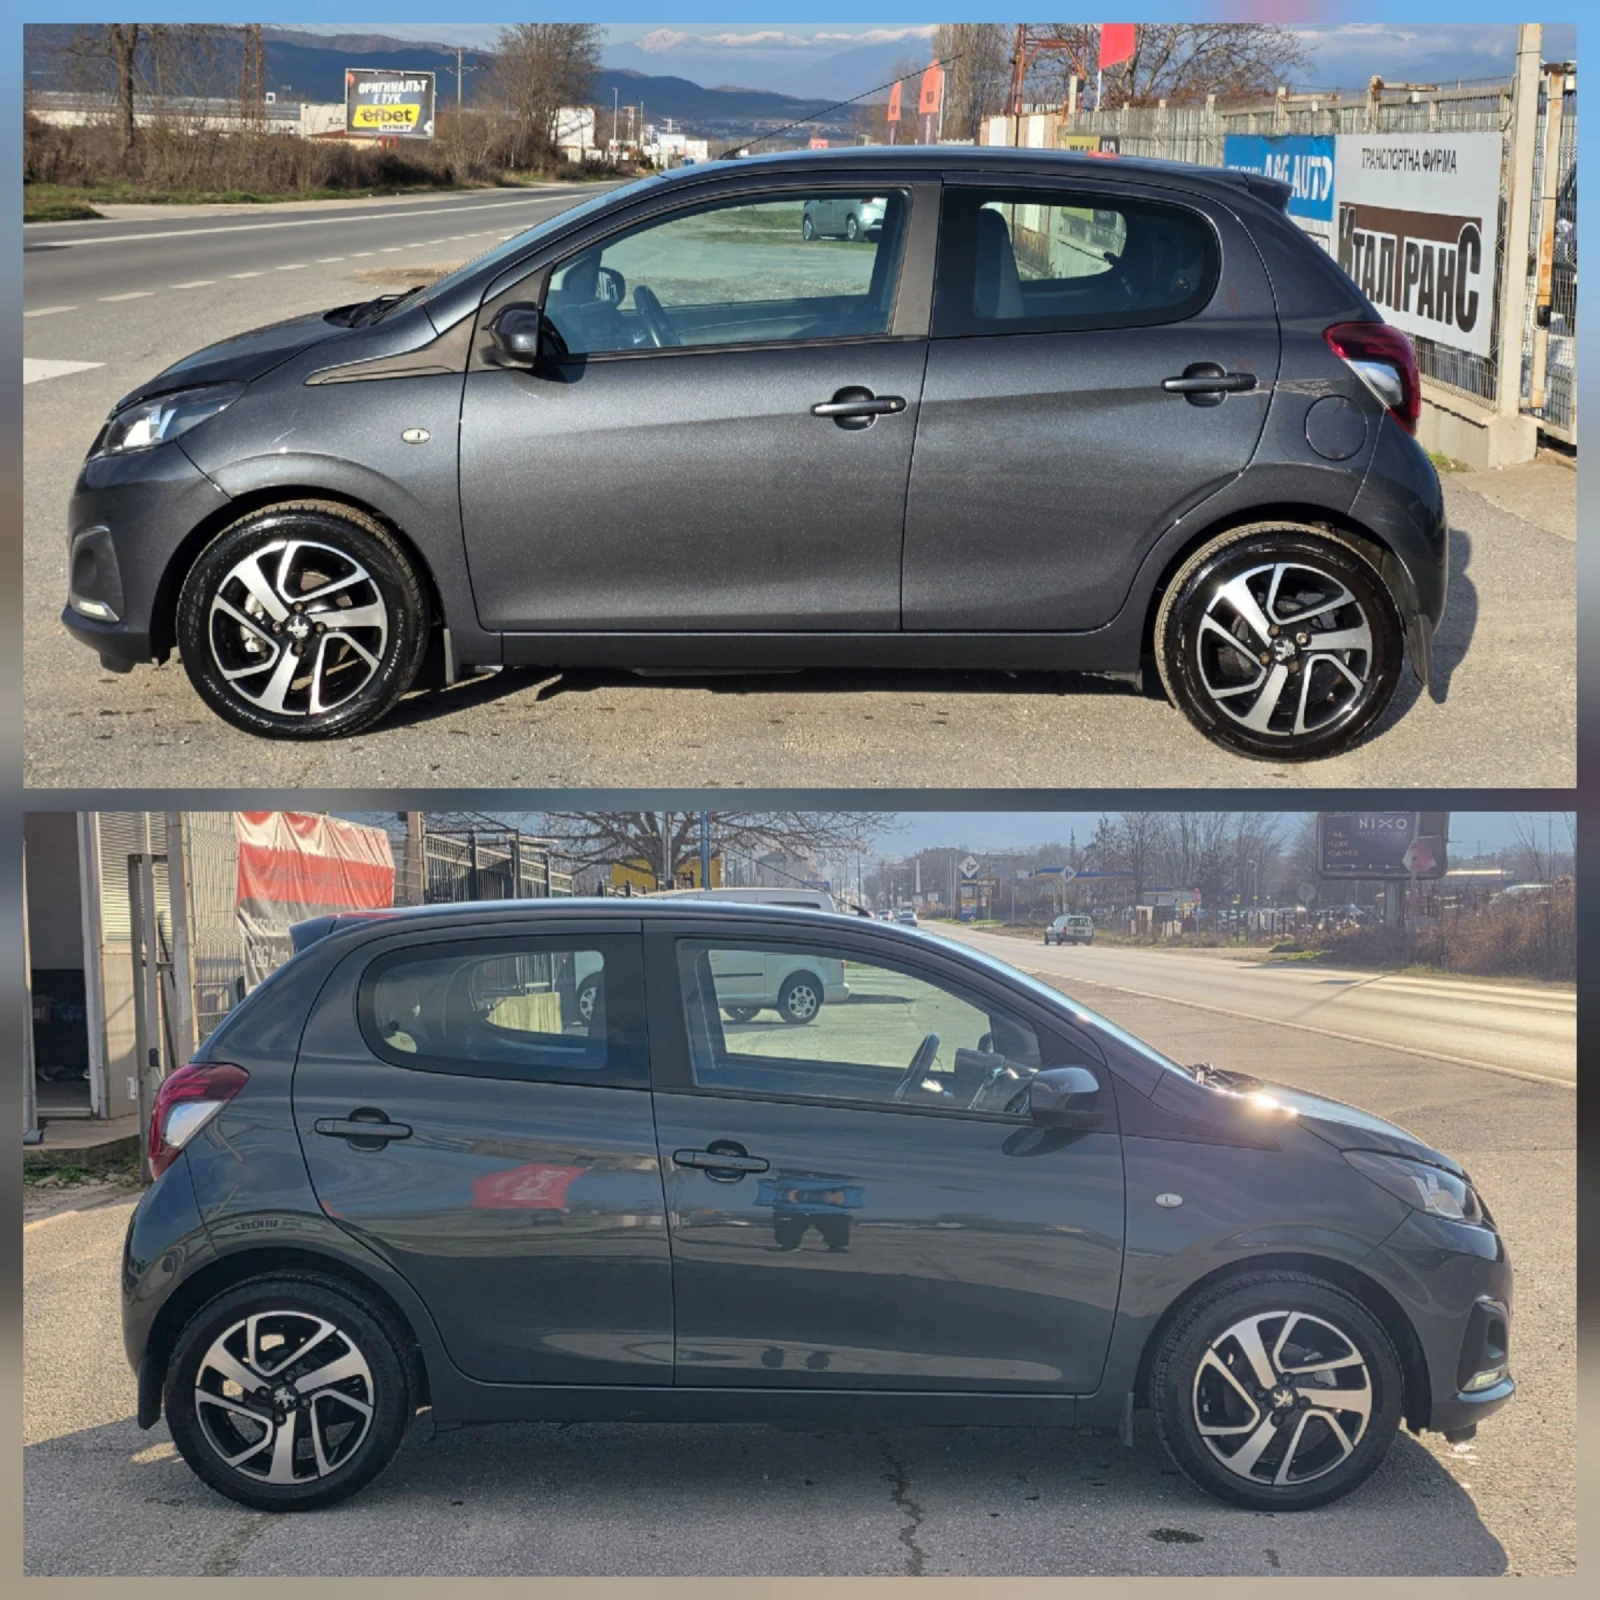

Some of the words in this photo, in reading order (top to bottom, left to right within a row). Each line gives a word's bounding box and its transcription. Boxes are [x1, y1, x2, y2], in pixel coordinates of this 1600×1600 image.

[358, 80, 428, 94] ОРИГИНАЛЪТ
[382, 93, 402, 104] ТУК
[362, 108, 413, 122] efbet
[1361, 147, 1421, 171] ТРАНСПОРТНА
[1423, 149, 1457, 174] ФИРМА
[1291, 154, 1333, 202] AUTO
[1359, 818, 1408, 829] NIXO
